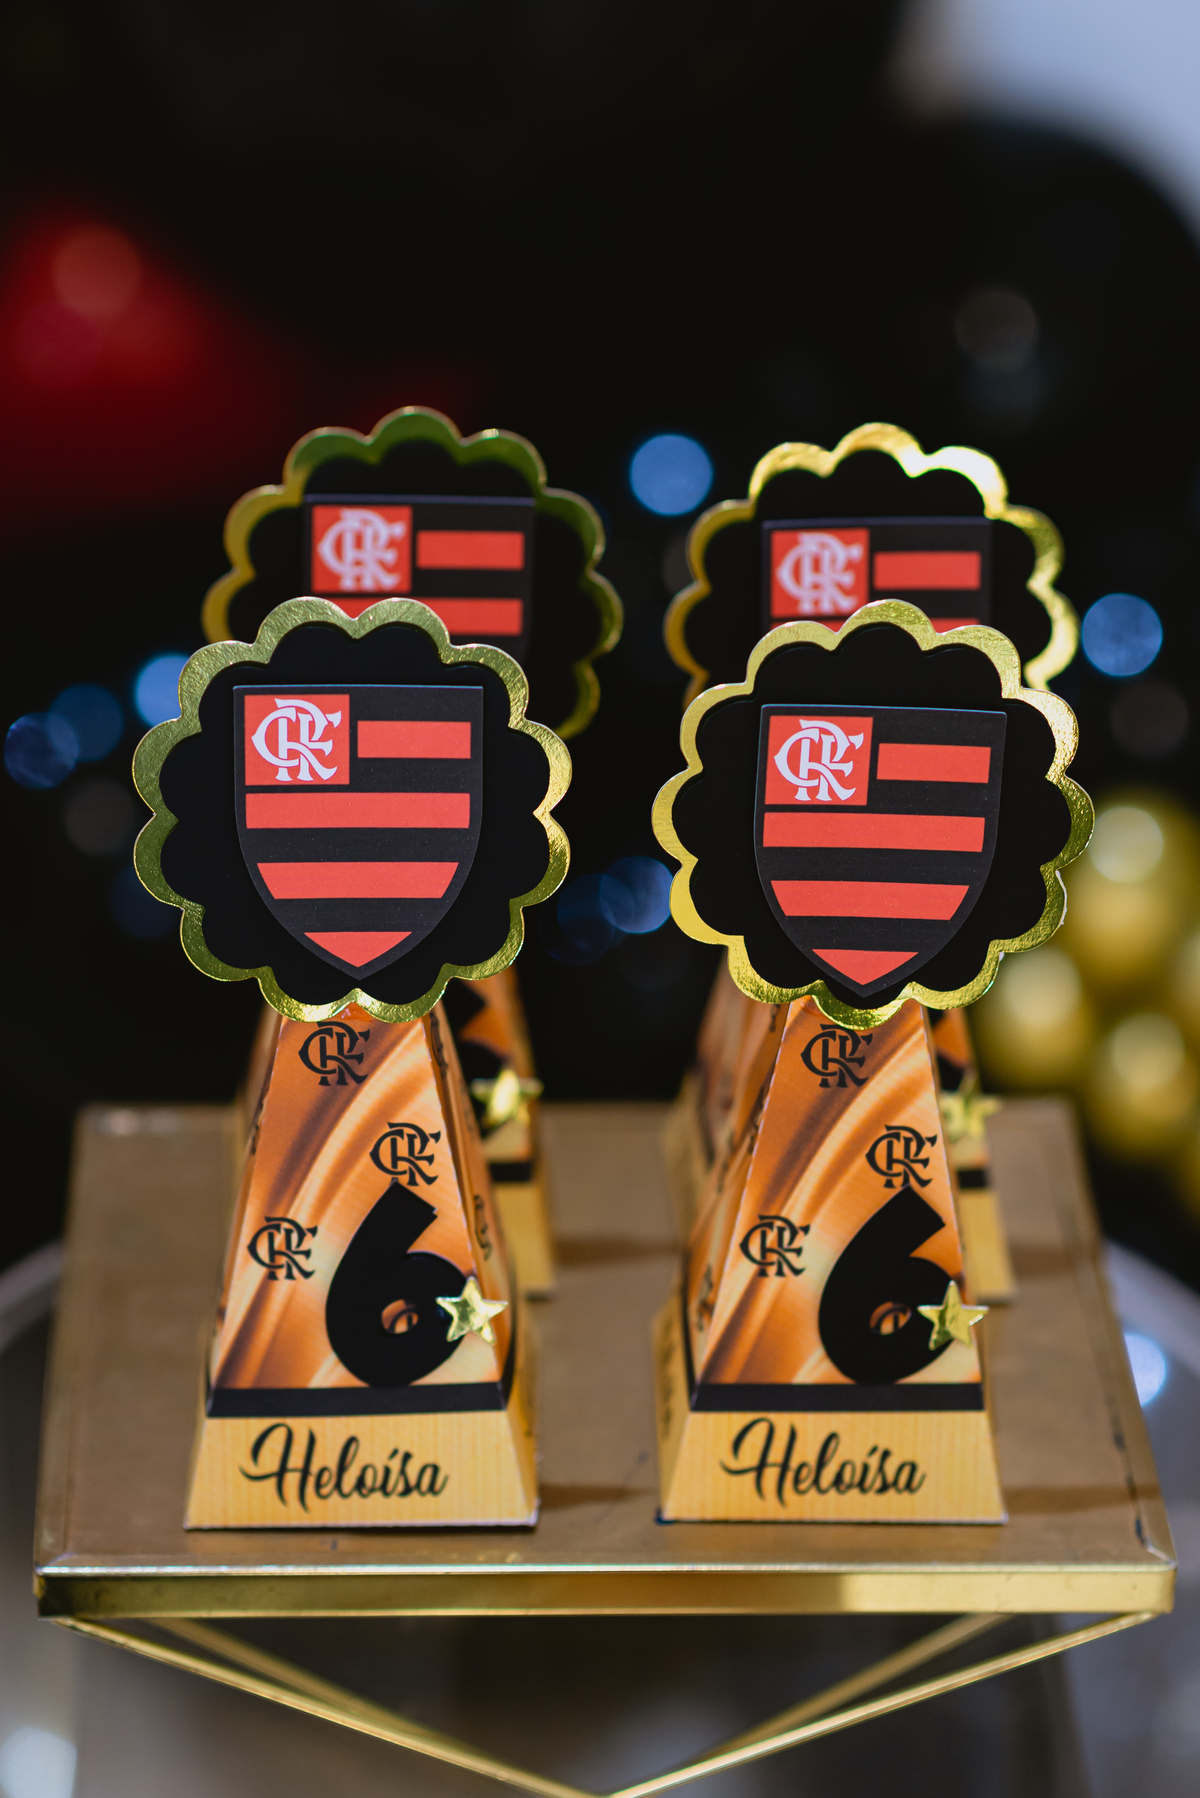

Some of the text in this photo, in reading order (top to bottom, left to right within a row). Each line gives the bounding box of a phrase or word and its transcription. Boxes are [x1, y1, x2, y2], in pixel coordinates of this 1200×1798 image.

[326, 1181, 469, 1389] 6
[819, 1184, 960, 1384] 6
[239, 1423, 448, 1512] Heloísa
[719, 1417, 928, 1507] Heloísa
